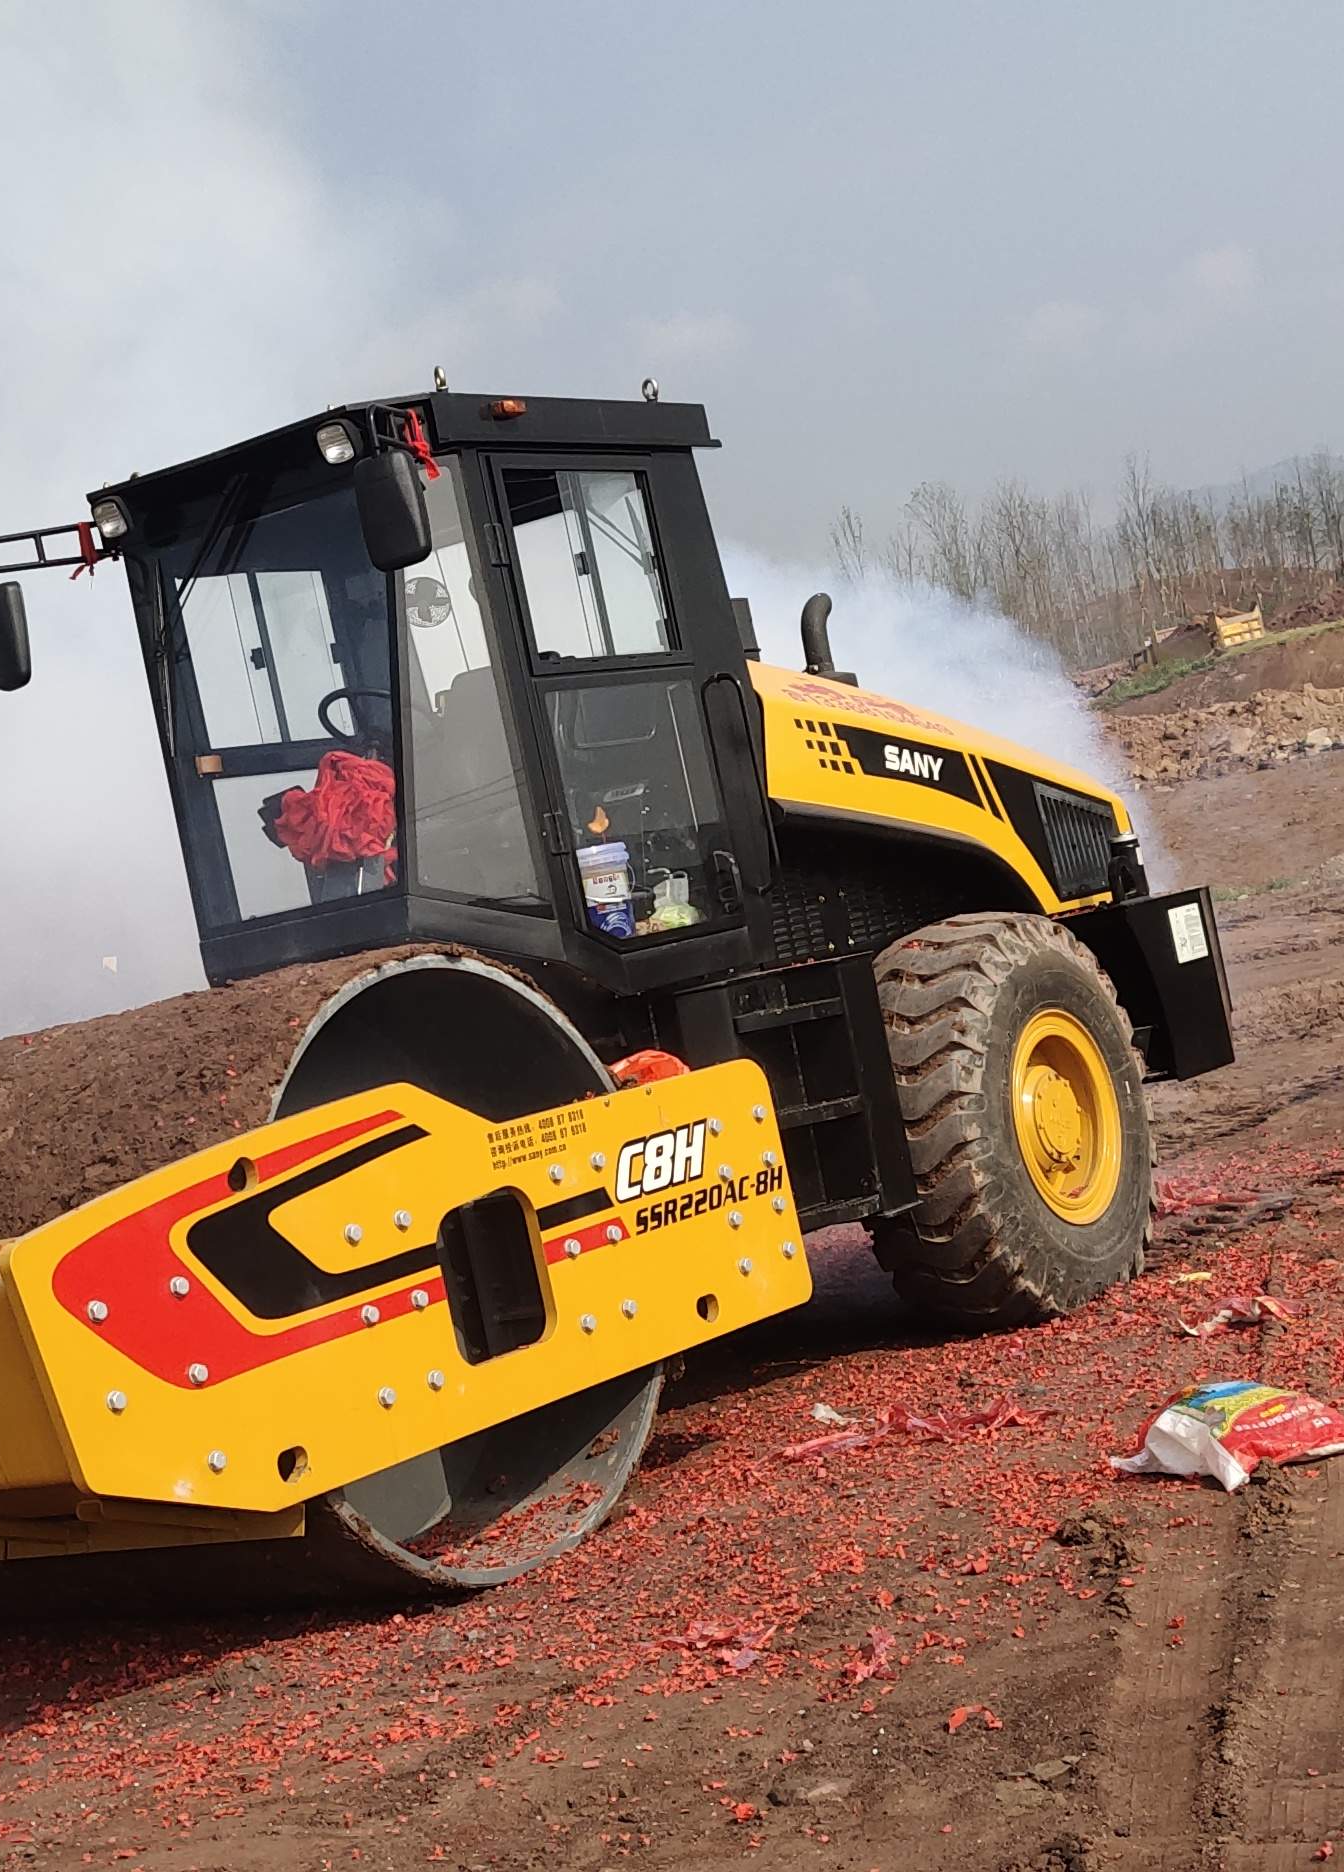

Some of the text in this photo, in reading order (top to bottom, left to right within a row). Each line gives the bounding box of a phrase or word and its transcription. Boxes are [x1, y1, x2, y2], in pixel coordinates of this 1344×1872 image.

[884, 745, 944, 782] SANY
[616, 1118, 707, 1203] C8H
[636, 1165, 783, 1236] SSR220AC-8H
